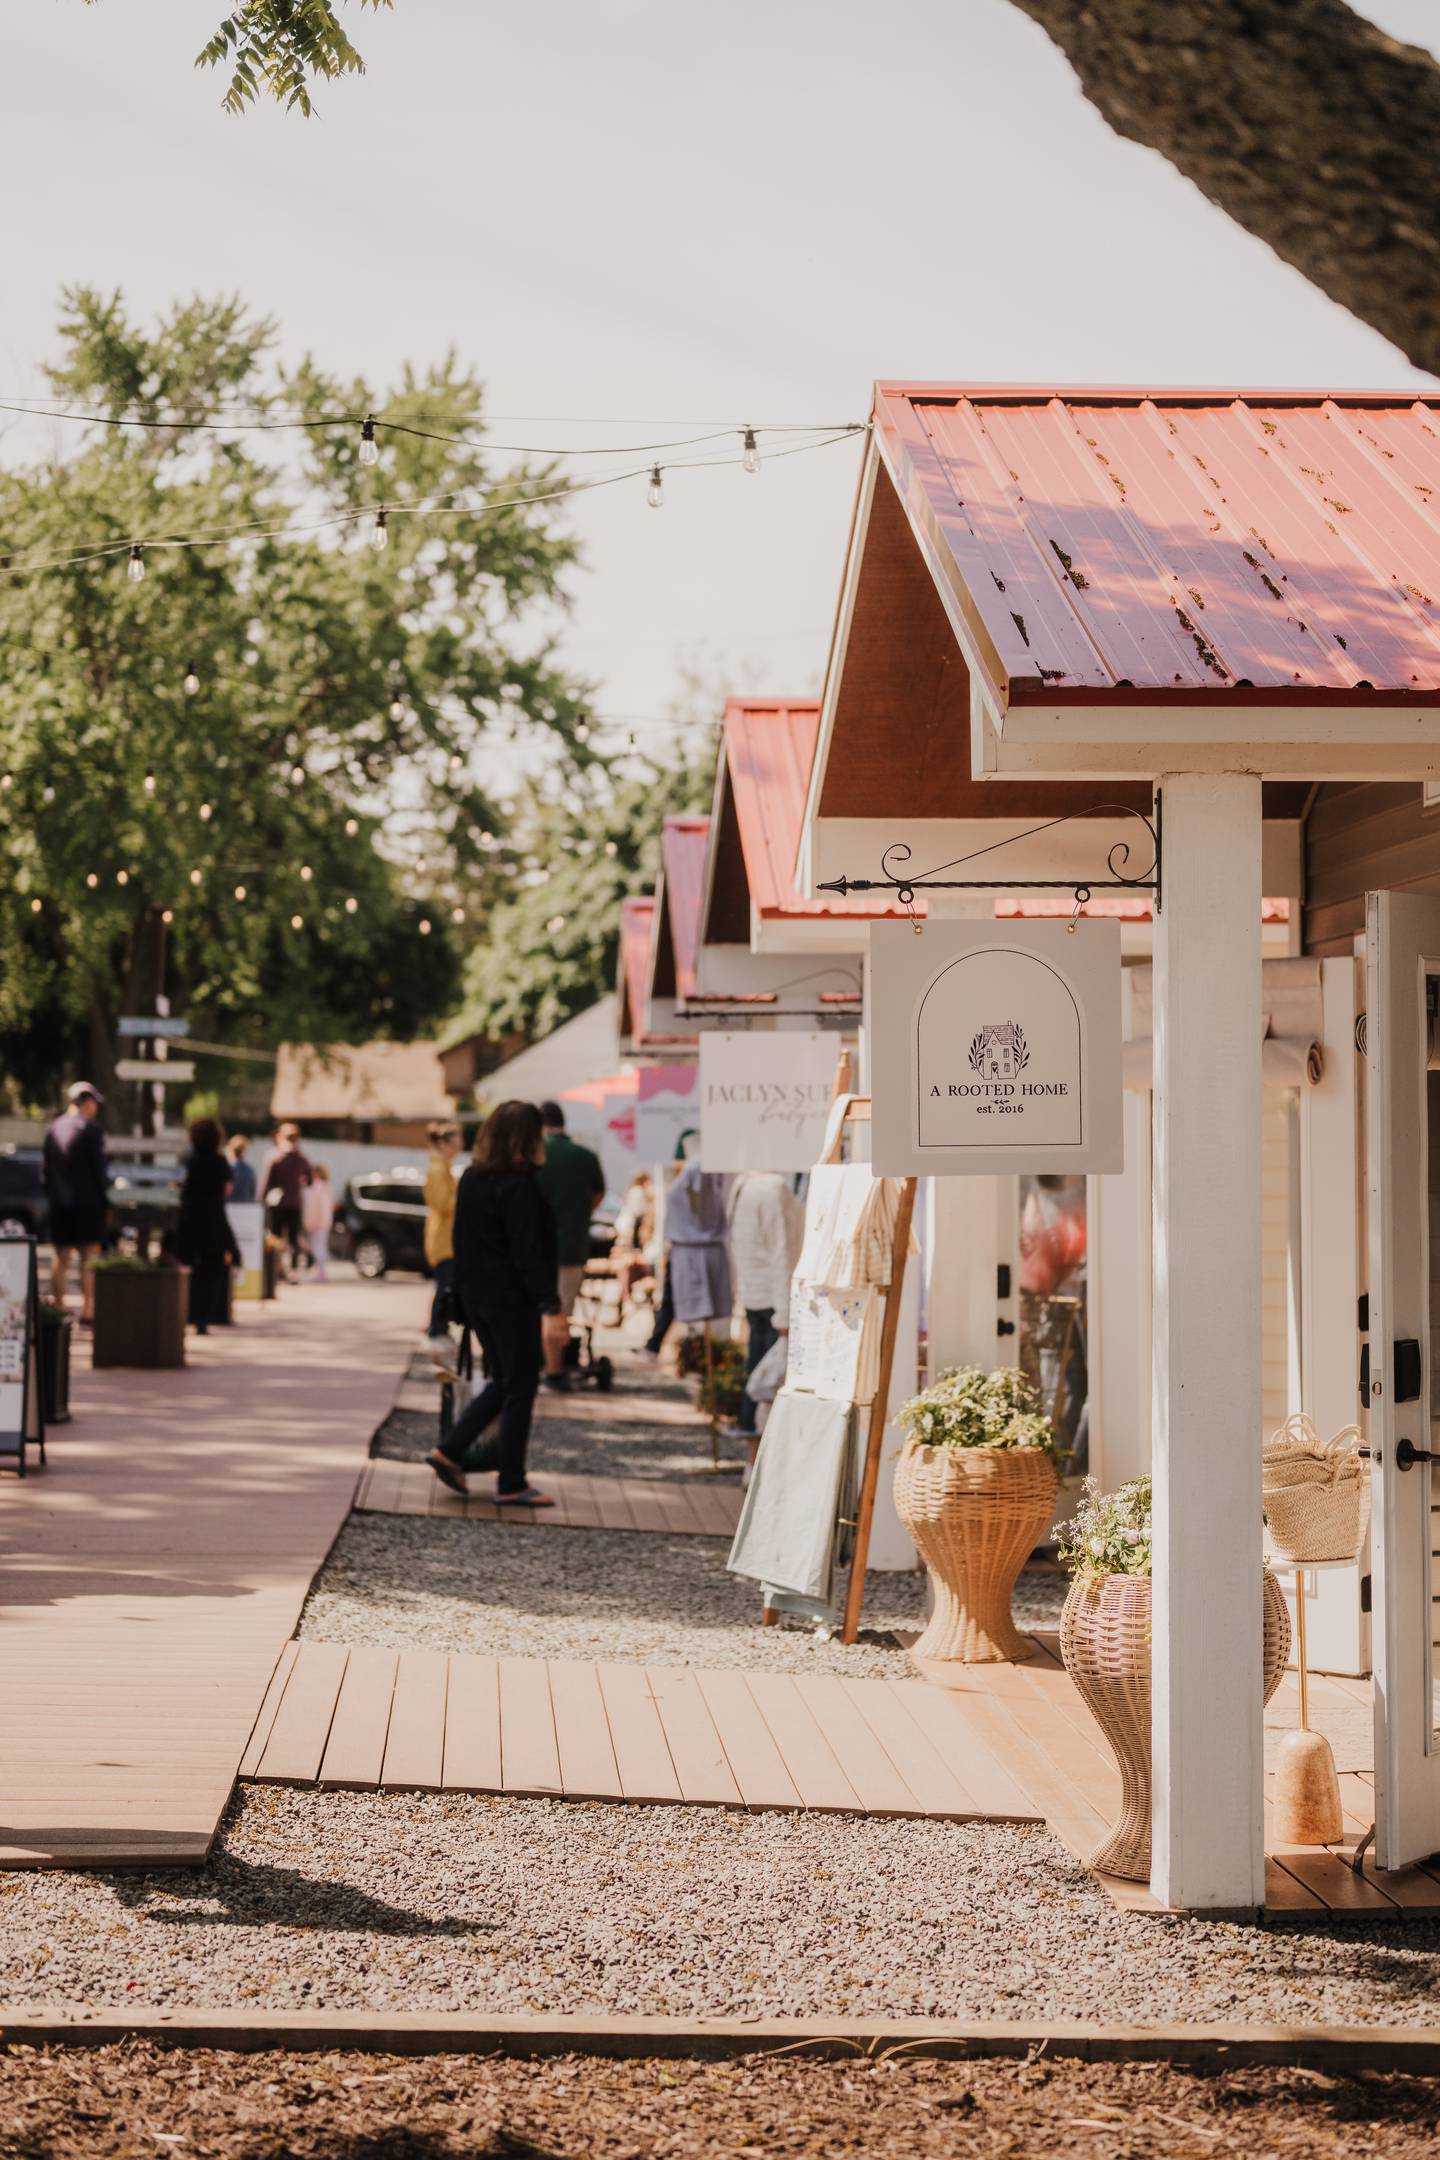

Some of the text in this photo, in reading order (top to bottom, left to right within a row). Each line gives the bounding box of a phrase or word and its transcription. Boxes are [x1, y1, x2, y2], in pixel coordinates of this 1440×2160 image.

[707, 1083, 789, 1106] JACLYN
[930, 1083, 1068, 1097] A ROOTED HOME
[976, 1103, 1024, 1114] est. 2016
